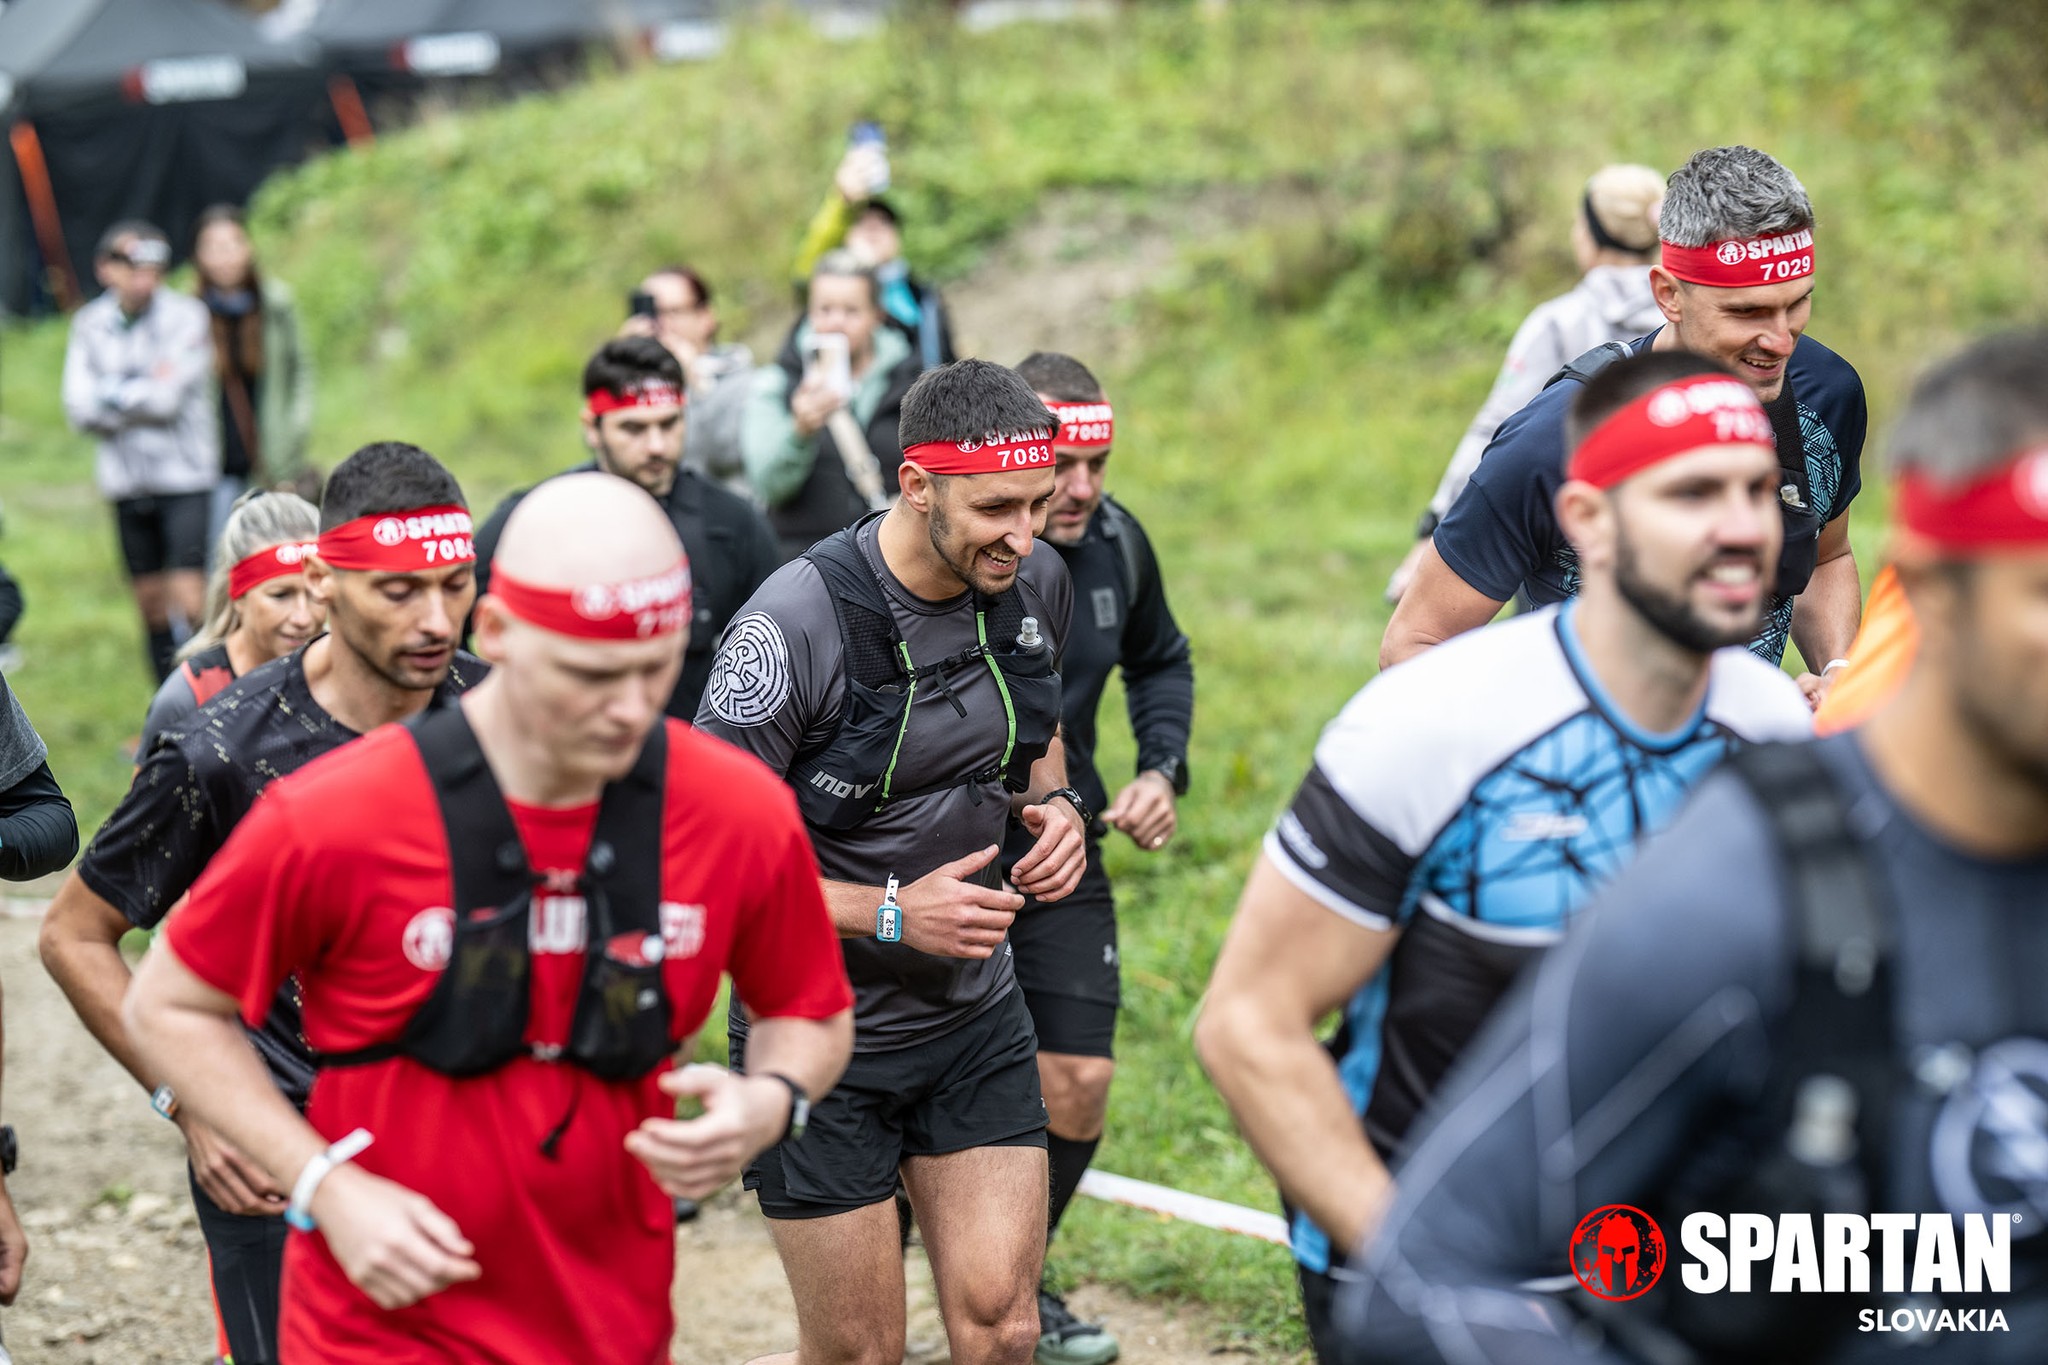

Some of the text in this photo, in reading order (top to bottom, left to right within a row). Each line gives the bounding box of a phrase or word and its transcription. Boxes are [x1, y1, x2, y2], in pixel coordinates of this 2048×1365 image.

[1747, 228, 1814, 260] SPARTA
[1760, 255, 1811, 281] 7029
[985, 427, 1051, 447] SPARTA
[997, 445, 1050, 468] 7083
[810, 768, 885, 799] INOV
